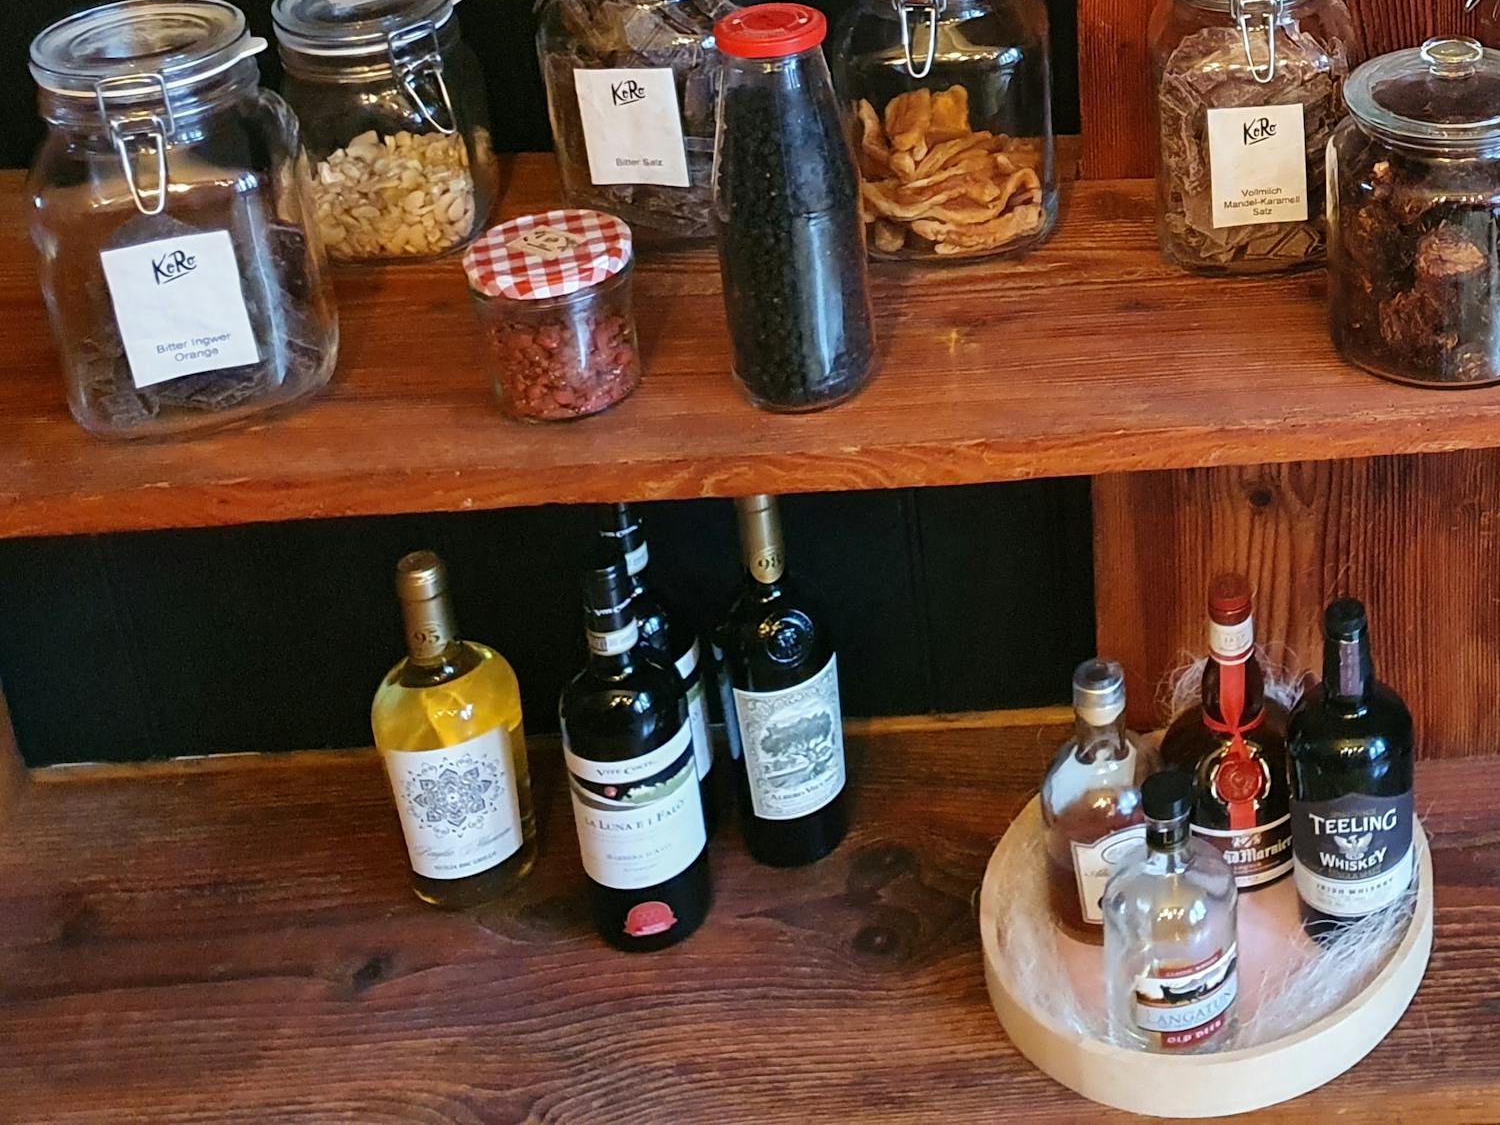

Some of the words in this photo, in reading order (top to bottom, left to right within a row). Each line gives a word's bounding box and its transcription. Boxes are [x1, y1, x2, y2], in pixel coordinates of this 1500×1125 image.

[1241, 187, 1282, 197] Vollmilch
[1223, 195, 1301, 209] Mandel-Karamell
[156, 340, 188, 354] Bitter
[191, 332, 231, 347] Ingwer
[174, 346, 220, 362] Orange
[1309, 808, 1397, 835] TEELING
[1320, 846, 1388, 872] WHISKEY
[1316, 883, 1345, 894] IRISH
[1146, 991, 1232, 1026] LANGATUN
[1166, 1034, 1192, 1044] OLD
